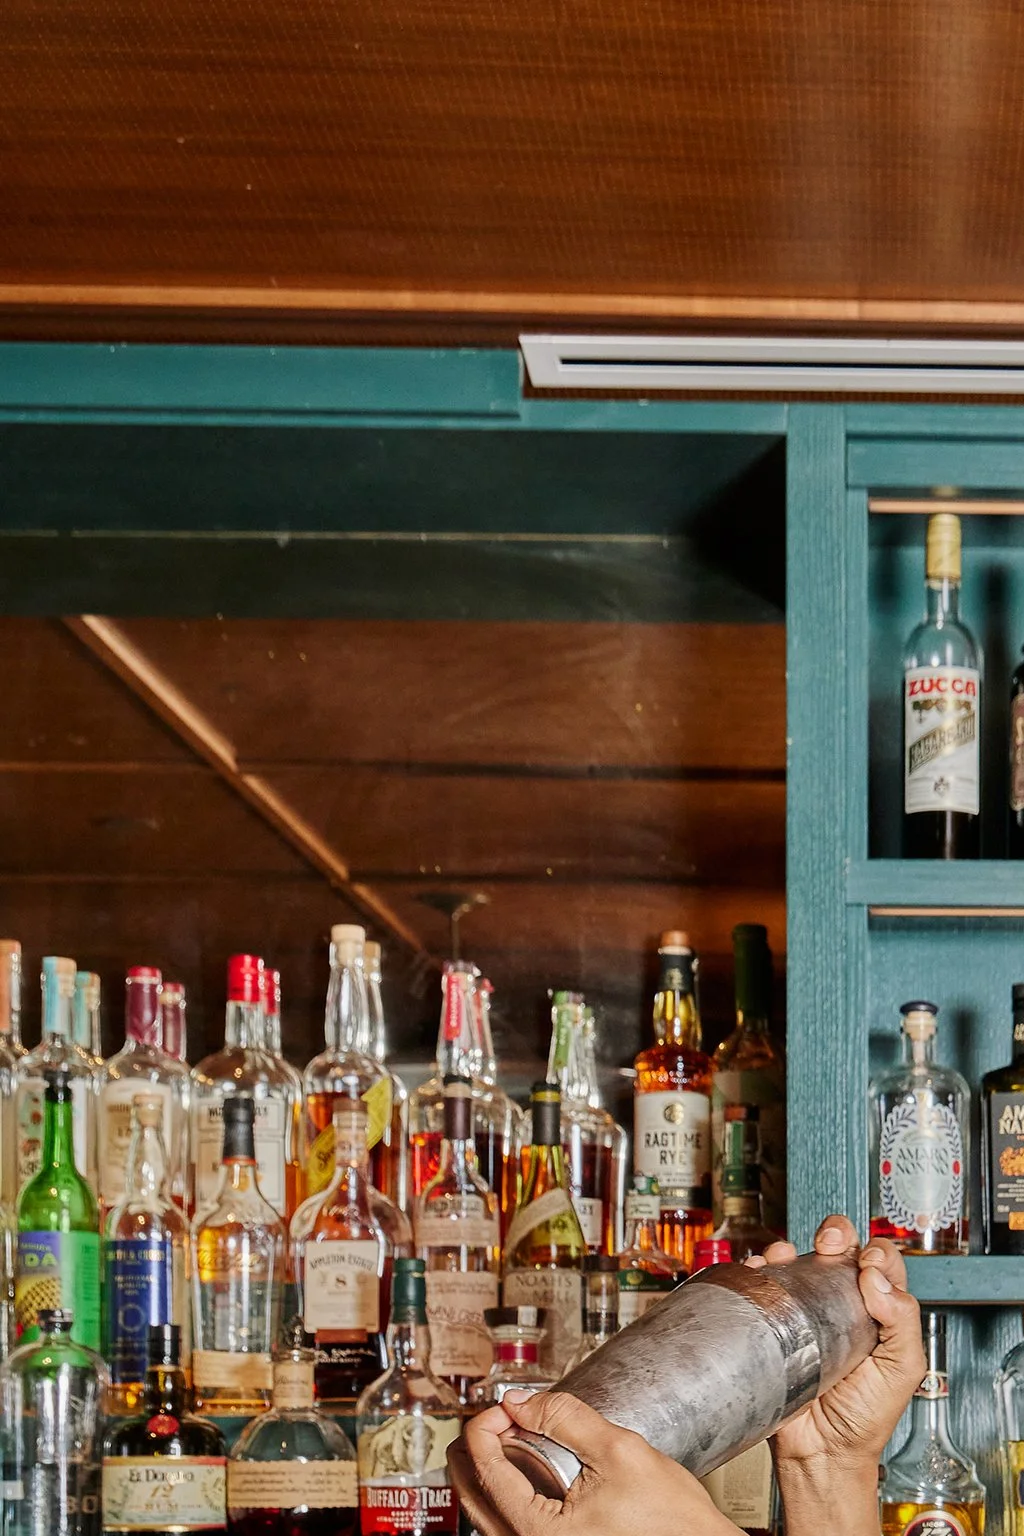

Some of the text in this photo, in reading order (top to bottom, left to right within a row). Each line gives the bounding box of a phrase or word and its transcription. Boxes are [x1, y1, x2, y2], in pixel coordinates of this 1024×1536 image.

[908, 676, 976, 697] ZUCCA
[367, 1487, 452, 1509] BUFFALO TRACE
